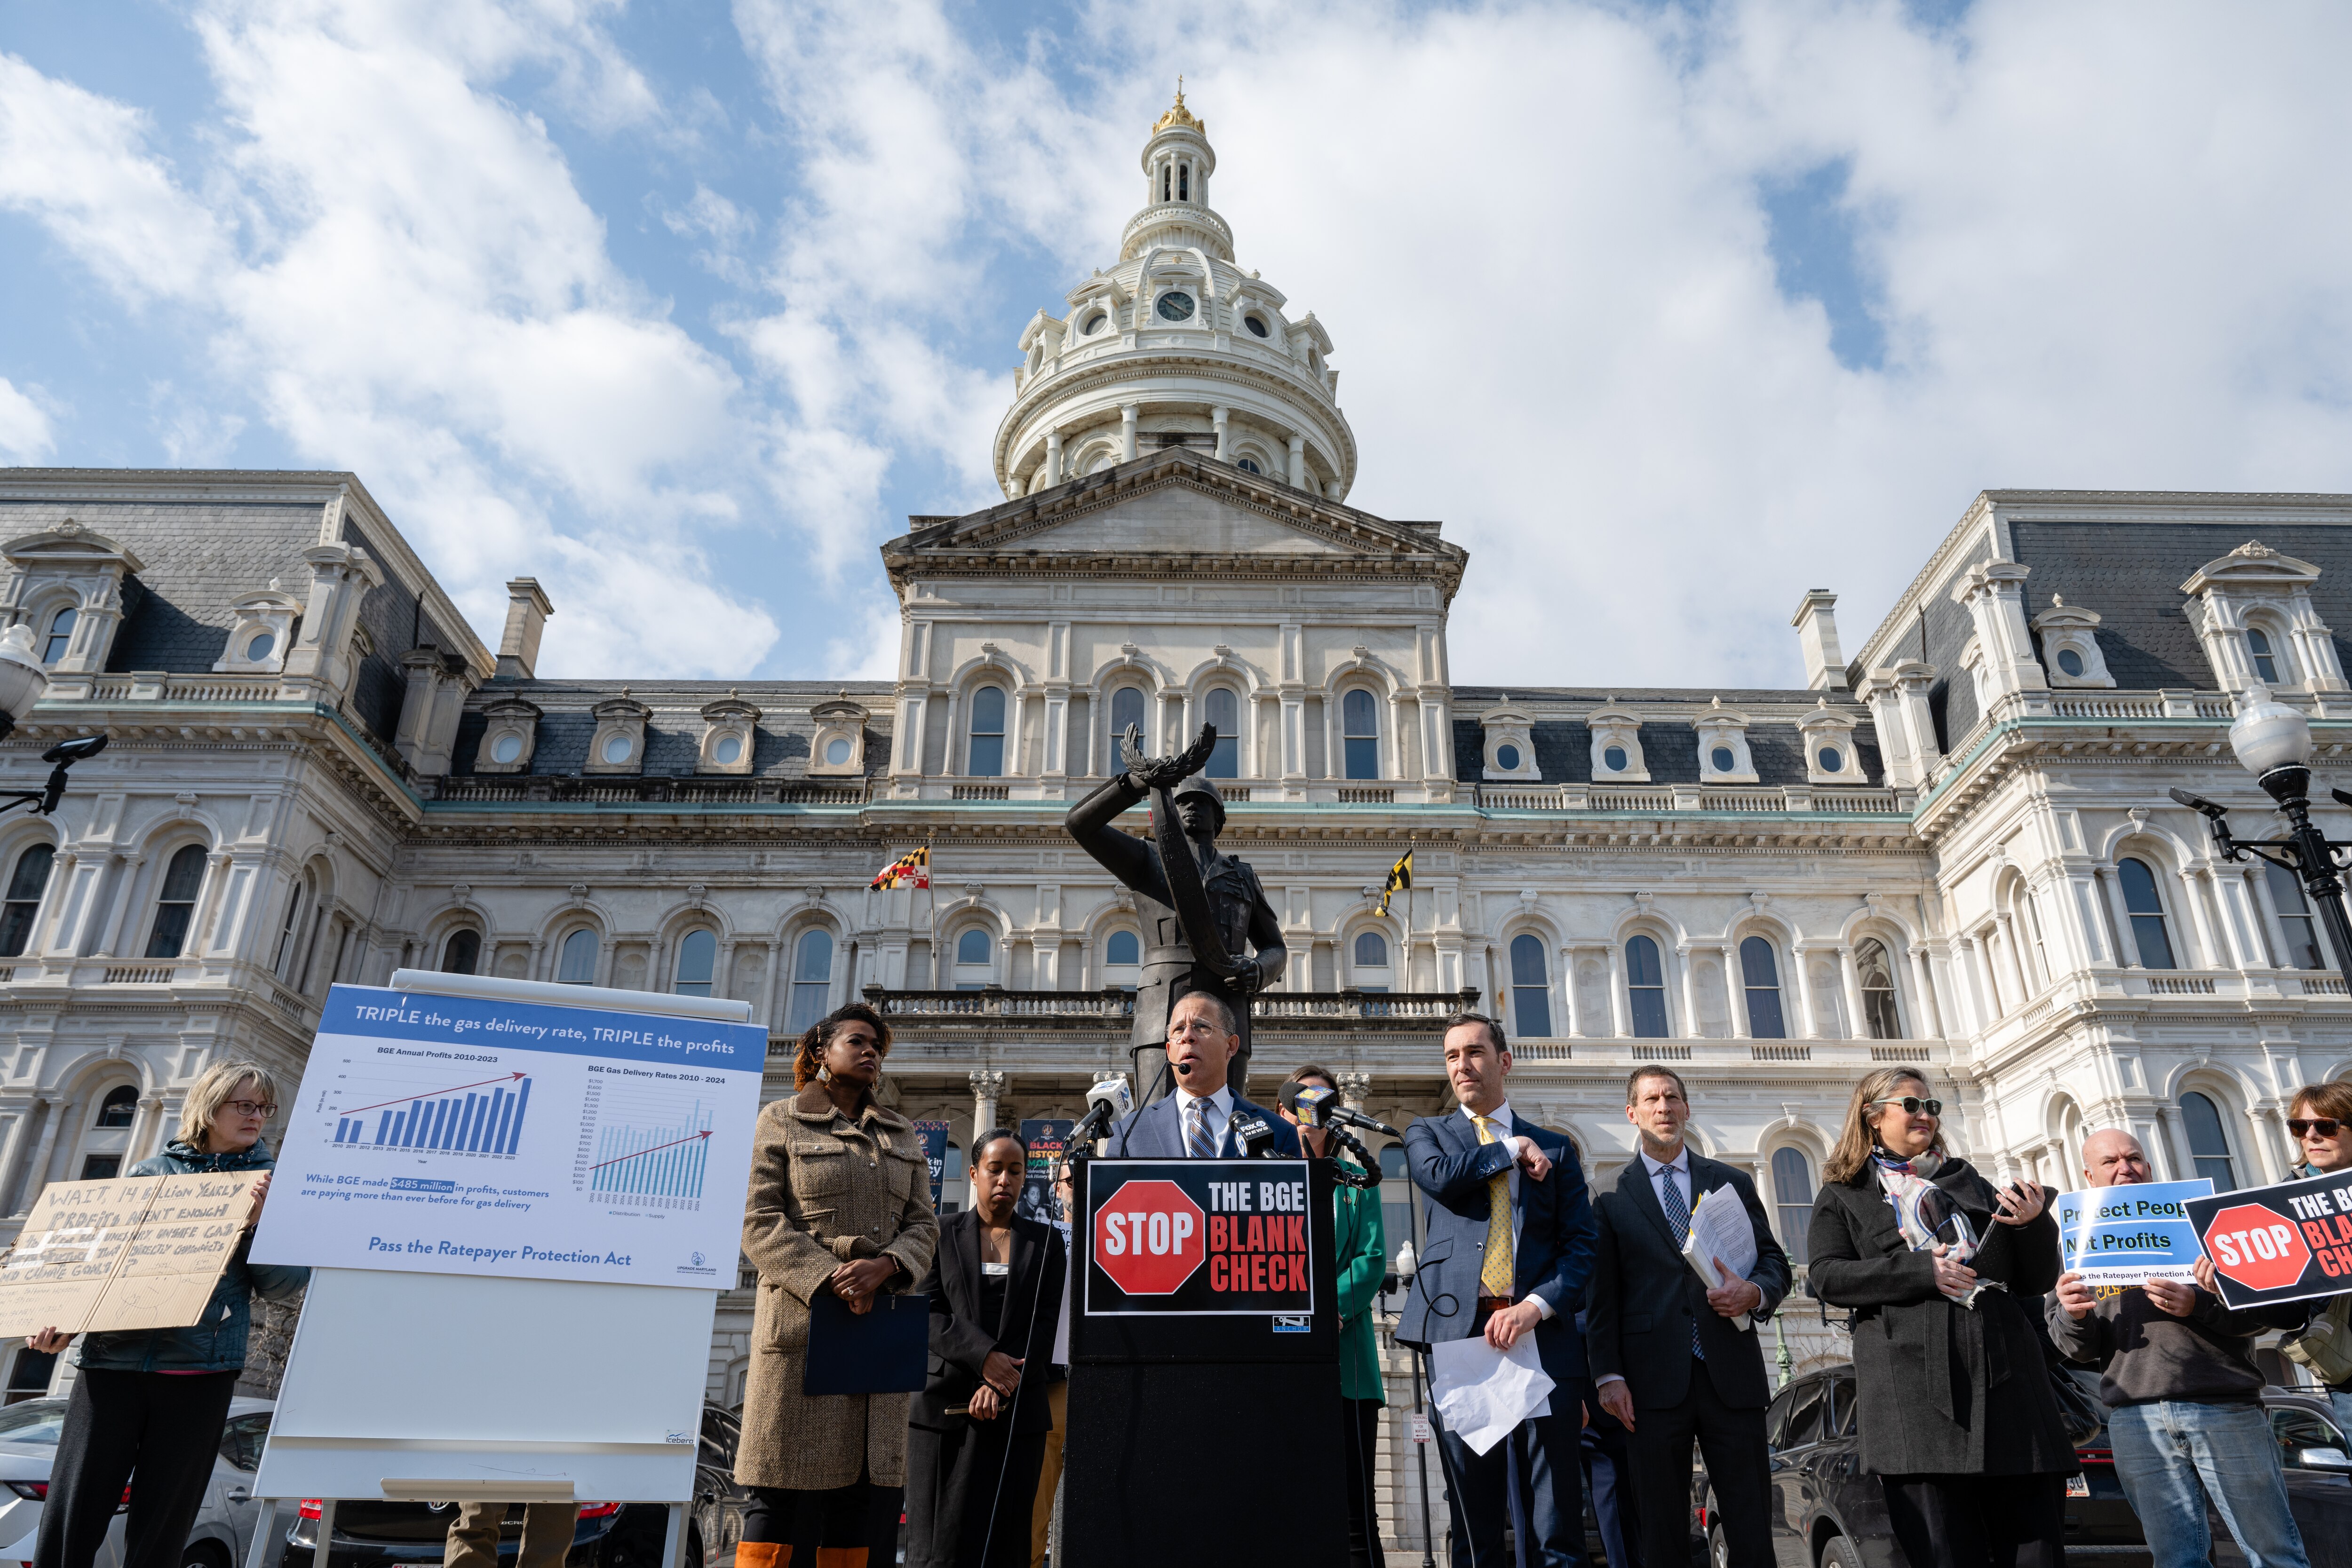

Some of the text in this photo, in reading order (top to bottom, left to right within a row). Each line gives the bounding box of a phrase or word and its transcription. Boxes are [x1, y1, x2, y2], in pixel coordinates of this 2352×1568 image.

[356, 1006, 734, 1054] TRIPLE the gas delivery rate, TRIPLE the profits
[454, 1053, 498, 1062] 2010-2023
[623, 1069, 653, 1078] Delivery
[1240, 1123, 1257, 1132] FOX
[1245, 1126, 1269, 1136] NEWS
[307, 1174, 334, 1183] While
[337, 1176, 361, 1185] BGE
[362, 1178, 389, 1187] made
[390, 1178, 418, 1189] $485
[420, 1180, 453, 1192] million
[455, 1183, 464, 1192] in
[466, 1185, 499, 1196] profits,
[1209, 1182, 1304, 1211] THE BGE
[318, 1189, 351, 1201] paying
[381, 1192, 403, 1201] than
[428, 1195, 458, 1204] before
[461, 1196, 475, 1205] for
[476, 1201, 492, 1209] gas
[494, 1199, 531, 1212] delivery
[2288, 1192, 2335, 1220] THE
[1106, 1212, 1193, 1255] STOP
[1211, 1216, 1306, 1251] BLANK
[2102, 1232, 2172, 1250] Profits
[2214, 1225, 2291, 1266] STOP
[2301, 1213, 2352, 1250] BLA
[369, 1237, 631, 1266] Pass the Ratepayer Protection Act
[1211, 1255, 1307, 1291] CHECK
[2103, 1272, 2141, 1281] Ratepayer
